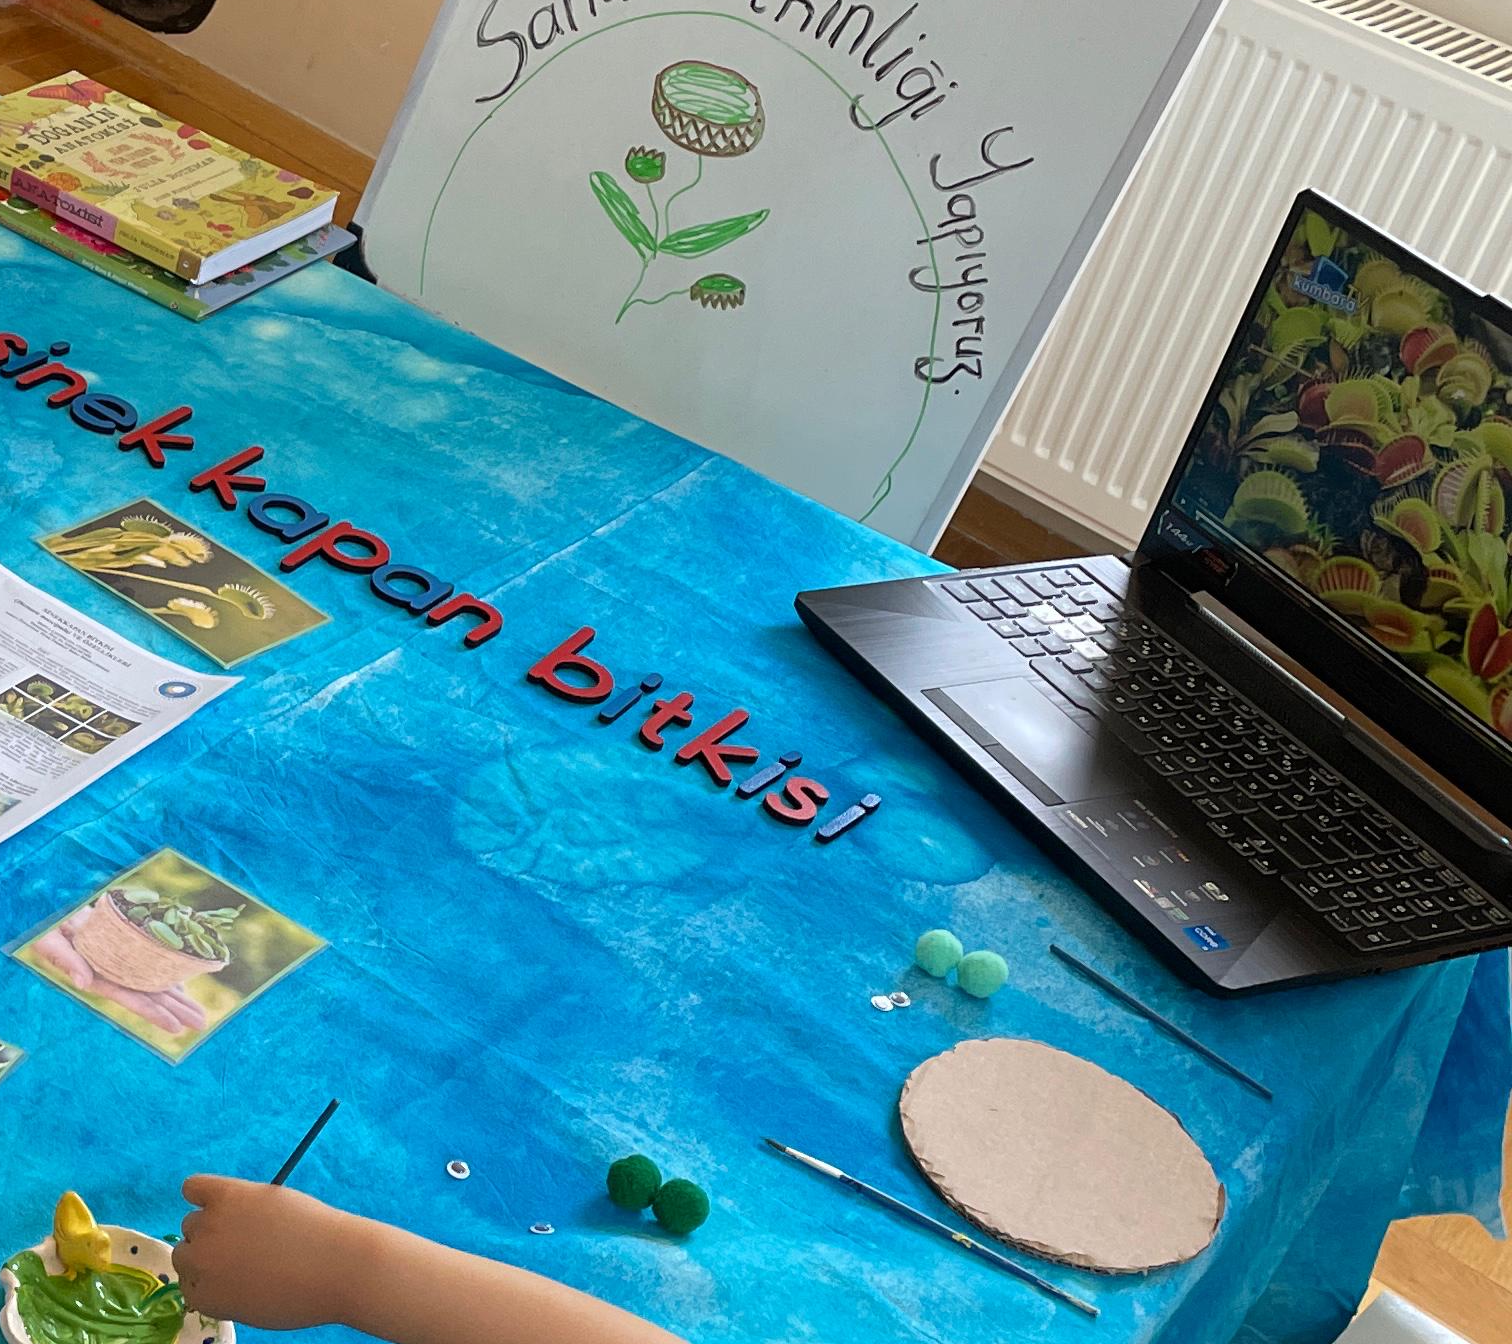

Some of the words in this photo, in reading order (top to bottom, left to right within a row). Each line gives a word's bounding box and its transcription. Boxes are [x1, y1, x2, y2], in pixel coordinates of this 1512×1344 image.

[1293, 275, 1356, 313] kumbara
[189, 446, 504, 648] kapan
[526, 625, 881, 843] bitkisi
